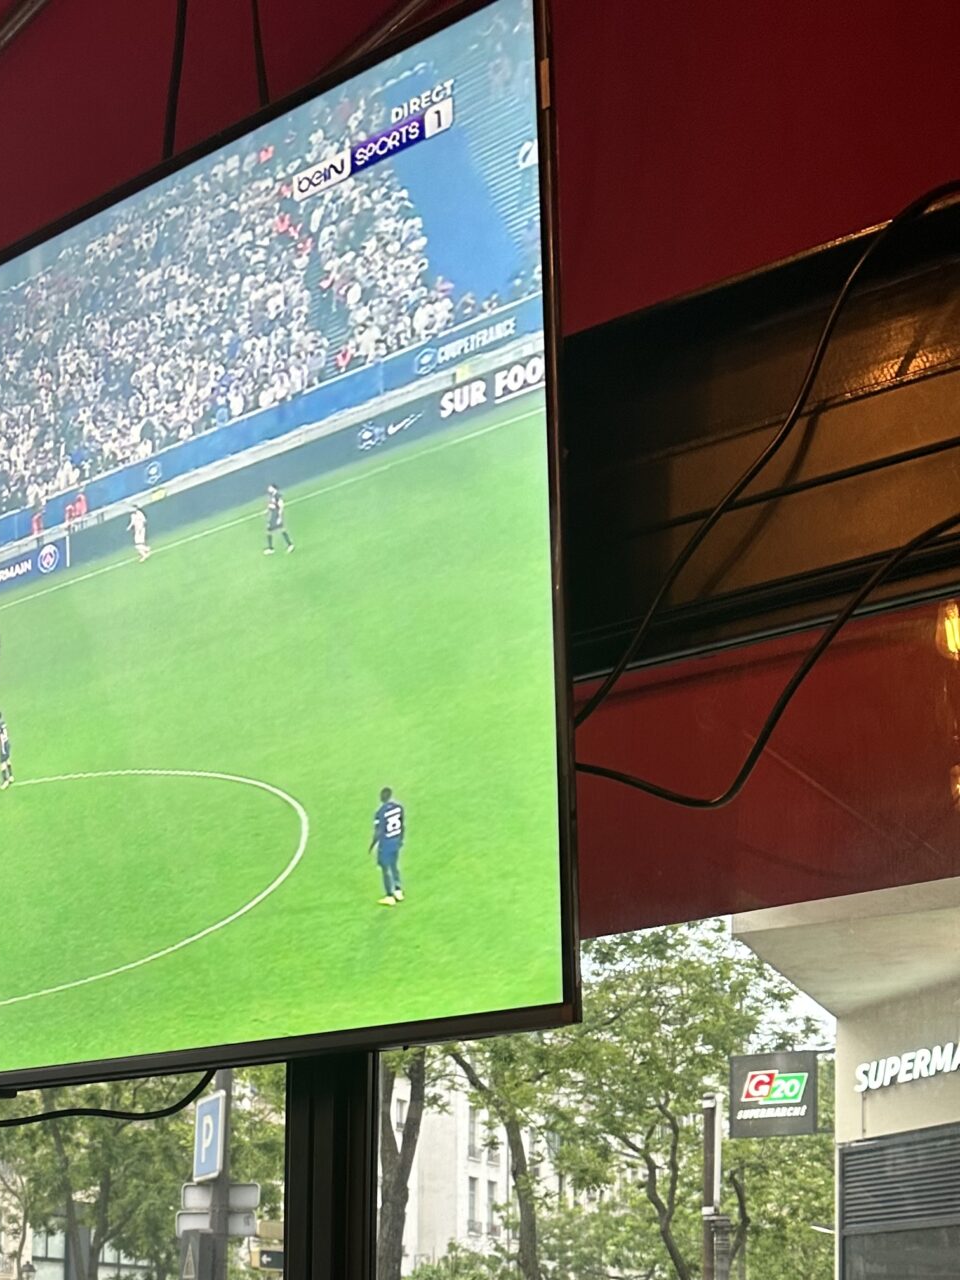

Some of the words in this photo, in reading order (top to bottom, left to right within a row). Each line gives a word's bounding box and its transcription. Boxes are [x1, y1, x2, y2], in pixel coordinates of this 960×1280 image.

[391, 79, 454, 124] DIRECT
[354, 121, 420, 165] SPORTS
[434, 109, 442, 129] 1
[440, 379, 487, 418] SUR
[495, 356, 544, 398] FOO
[201, 1114, 214, 1163] P
